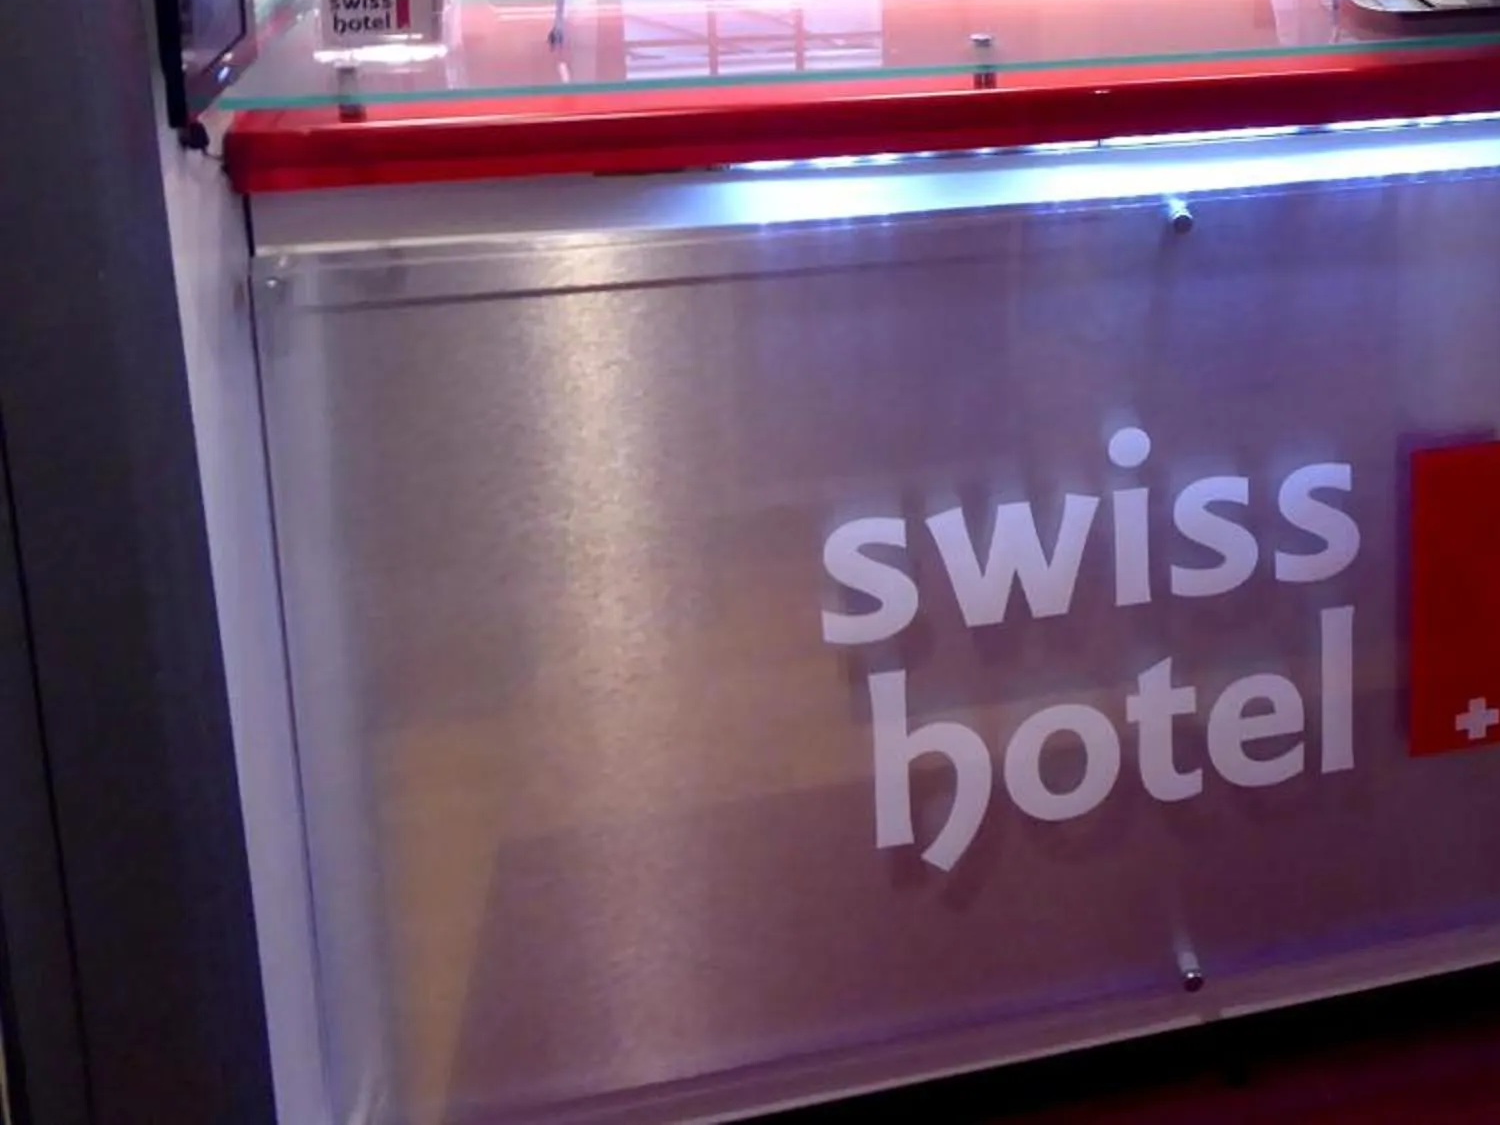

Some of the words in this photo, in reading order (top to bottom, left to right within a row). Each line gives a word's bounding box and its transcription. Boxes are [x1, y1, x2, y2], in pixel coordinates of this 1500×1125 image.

[333, 12, 391, 35] hotel
[821, 427, 1361, 645] swiss
[867, 605, 1355, 872] hotel
